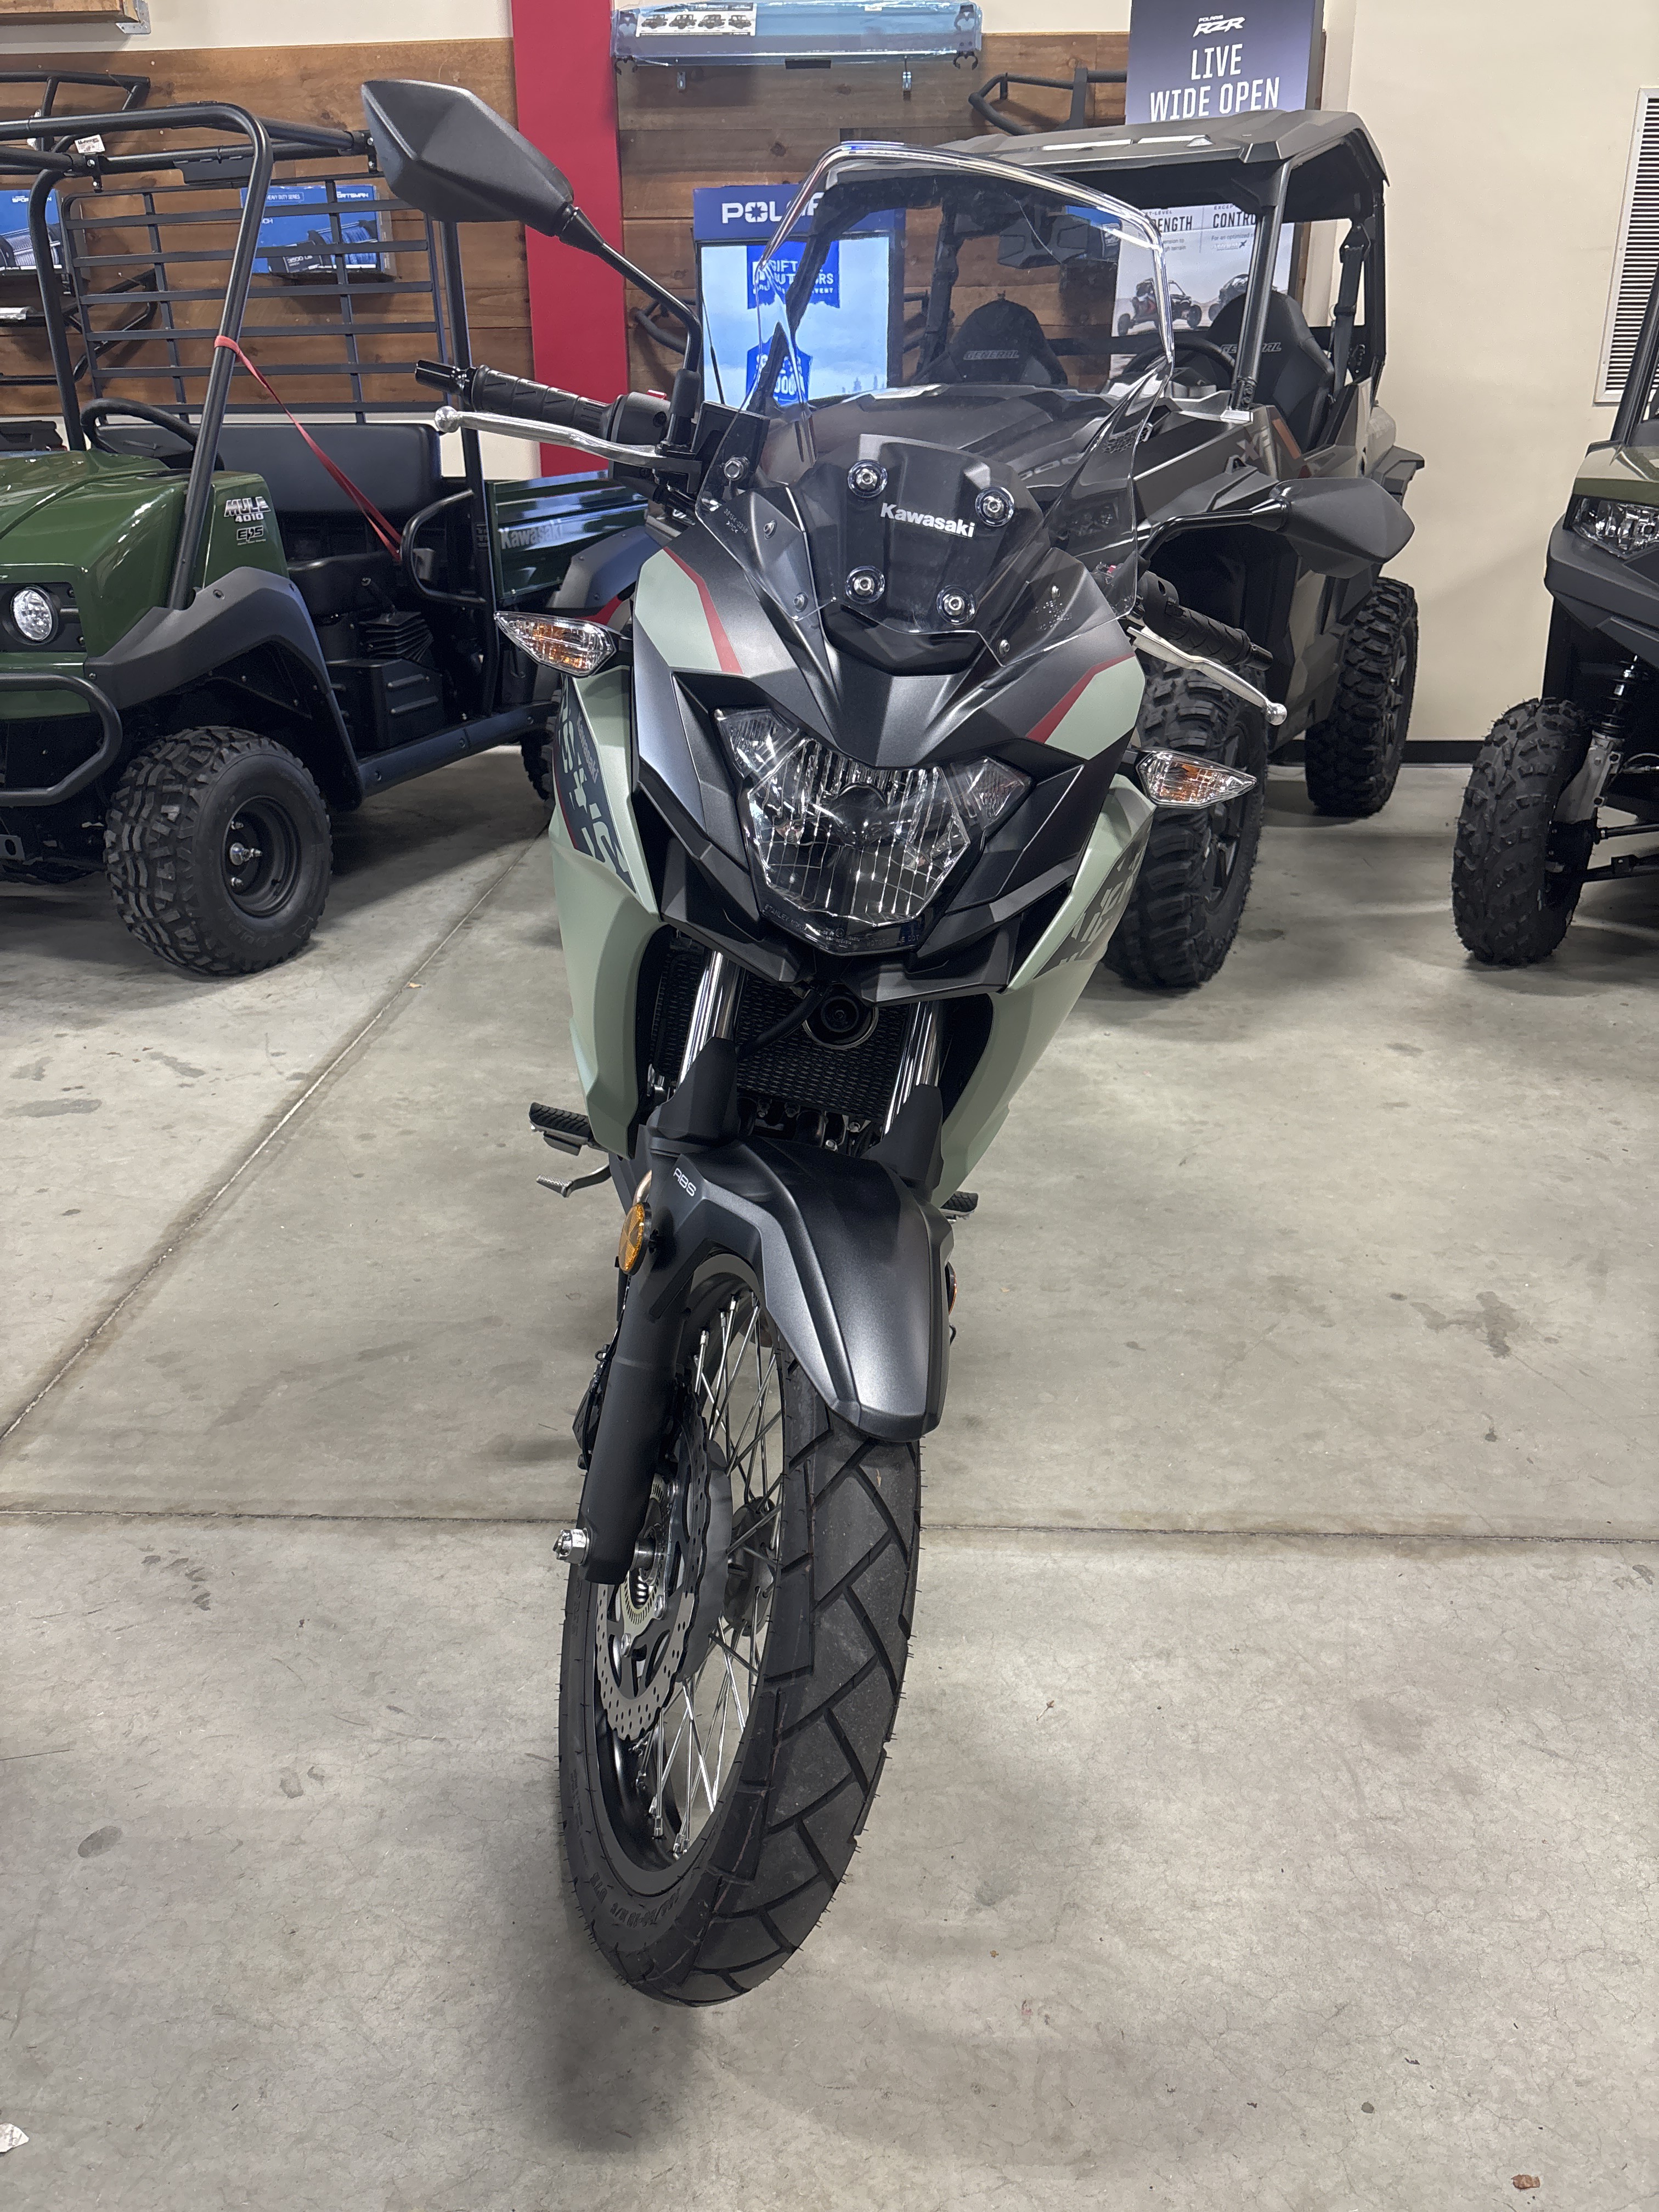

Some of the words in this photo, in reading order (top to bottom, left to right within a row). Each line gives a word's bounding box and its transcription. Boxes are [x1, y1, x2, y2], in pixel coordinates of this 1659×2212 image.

[1192, 16, 1245, 38] RZR
[1191, 43, 1243, 80] LIVE
[1150, 86, 1211, 122] WIDE
[1219, 77, 1279, 115] OPEN
[224, 496, 271, 517] MULE
[235, 512, 264, 523] 4010
[880, 502, 975, 538] Kawasaki
[236, 525, 263, 542] EPS
[498, 519, 563, 549] Kawasaki
[673, 1167, 697, 1197] ABS
